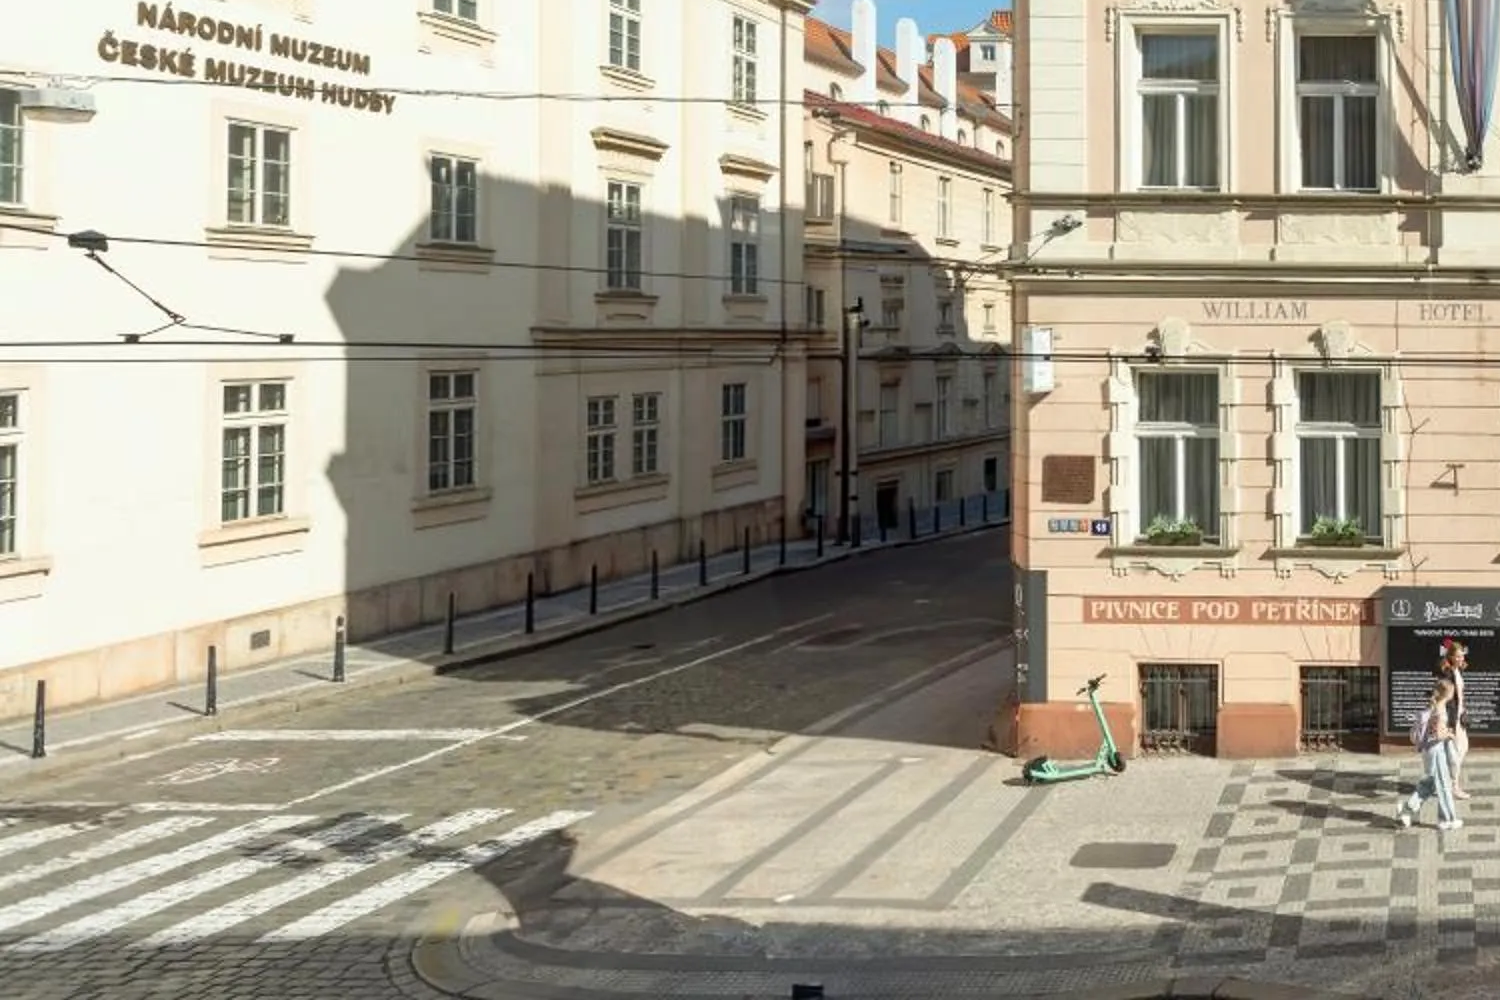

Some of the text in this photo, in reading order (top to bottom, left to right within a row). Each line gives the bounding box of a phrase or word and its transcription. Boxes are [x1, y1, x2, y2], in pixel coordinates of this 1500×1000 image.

[137, 1, 370, 76] NÁRODNÍ MUZEUM
[98, 29, 396, 115] ČESKÉ MUZEUM HUDBY
[1201, 301, 1308, 321] WILLIAM
[1418, 303, 1492, 321] HOTEL
[1090, 598, 1367, 621] PIVNICE POD PETŘÍNEM
